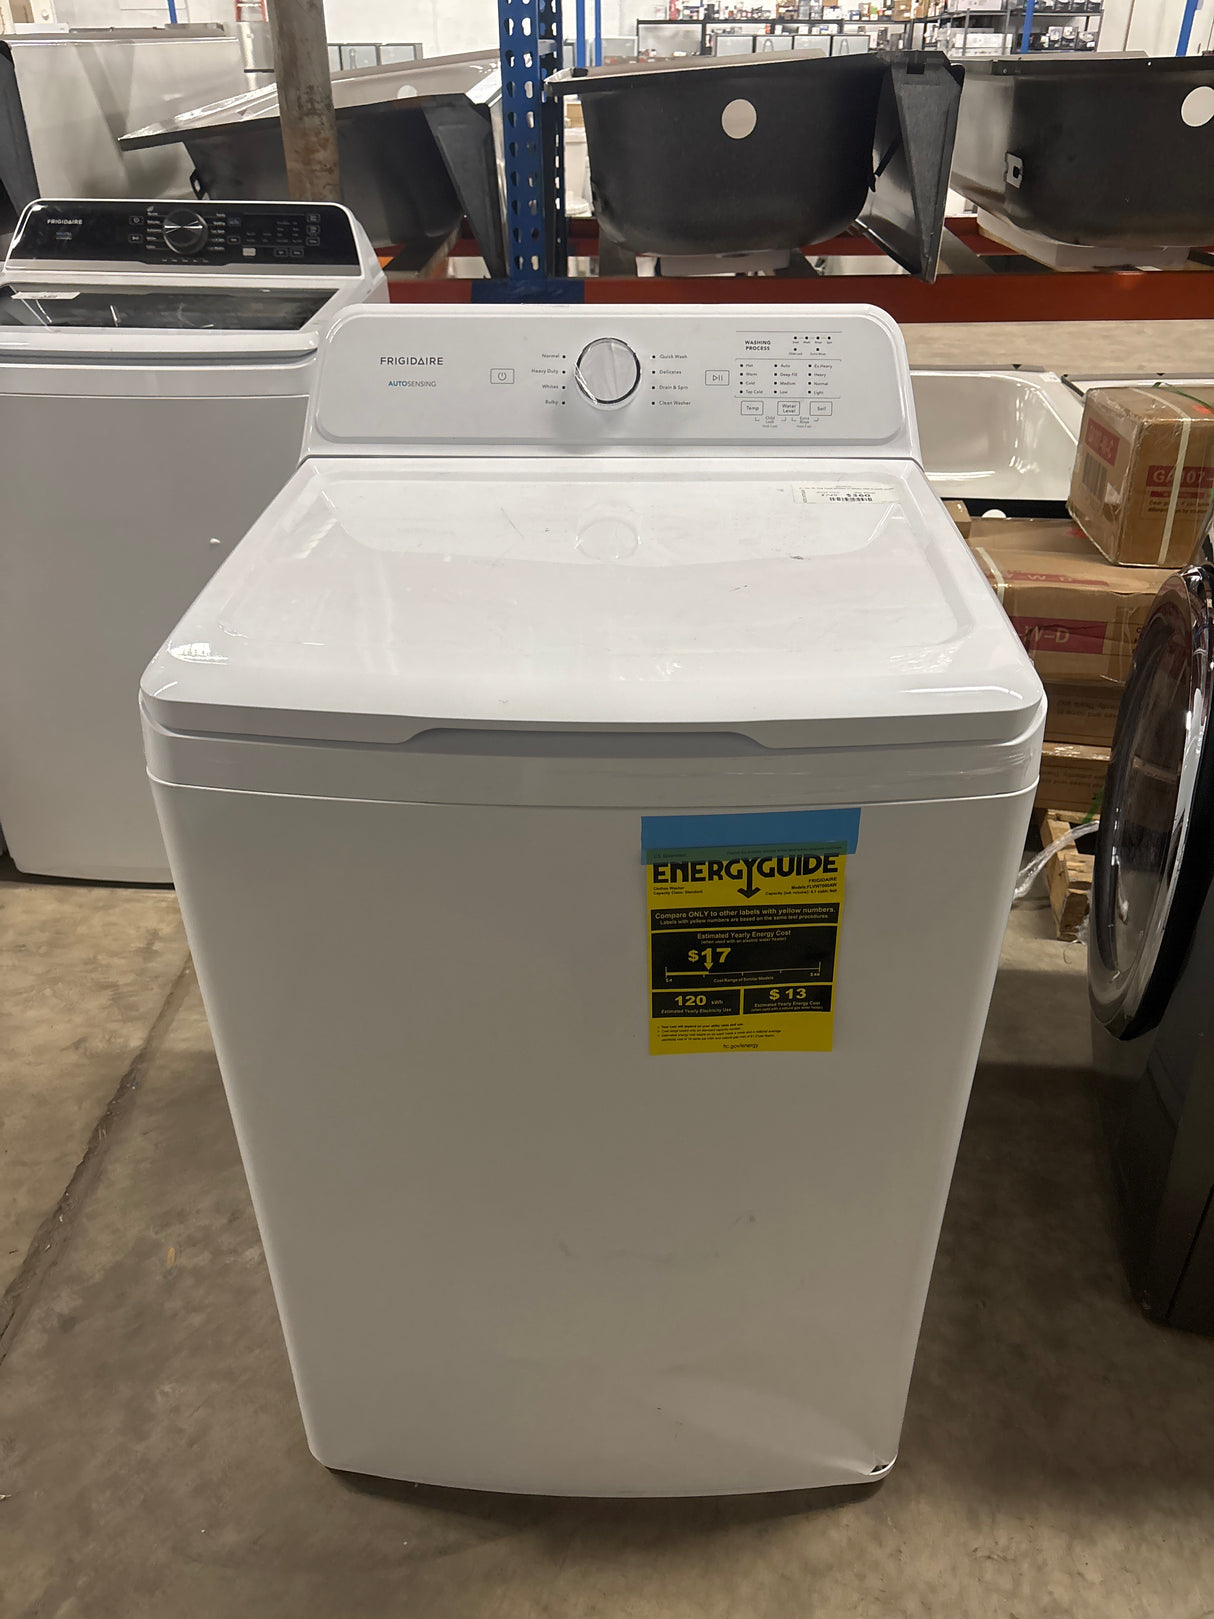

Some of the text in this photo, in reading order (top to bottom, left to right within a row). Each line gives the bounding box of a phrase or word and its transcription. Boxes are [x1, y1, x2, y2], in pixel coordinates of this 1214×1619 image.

[380, 357, 444, 365] FRIGIDAIRE
[653, 852, 840, 884] ENERGYGUIDE
[688, 948, 732, 963] $17
[674, 995, 707, 1006] 120
[769, 988, 807, 1001] $ 13
